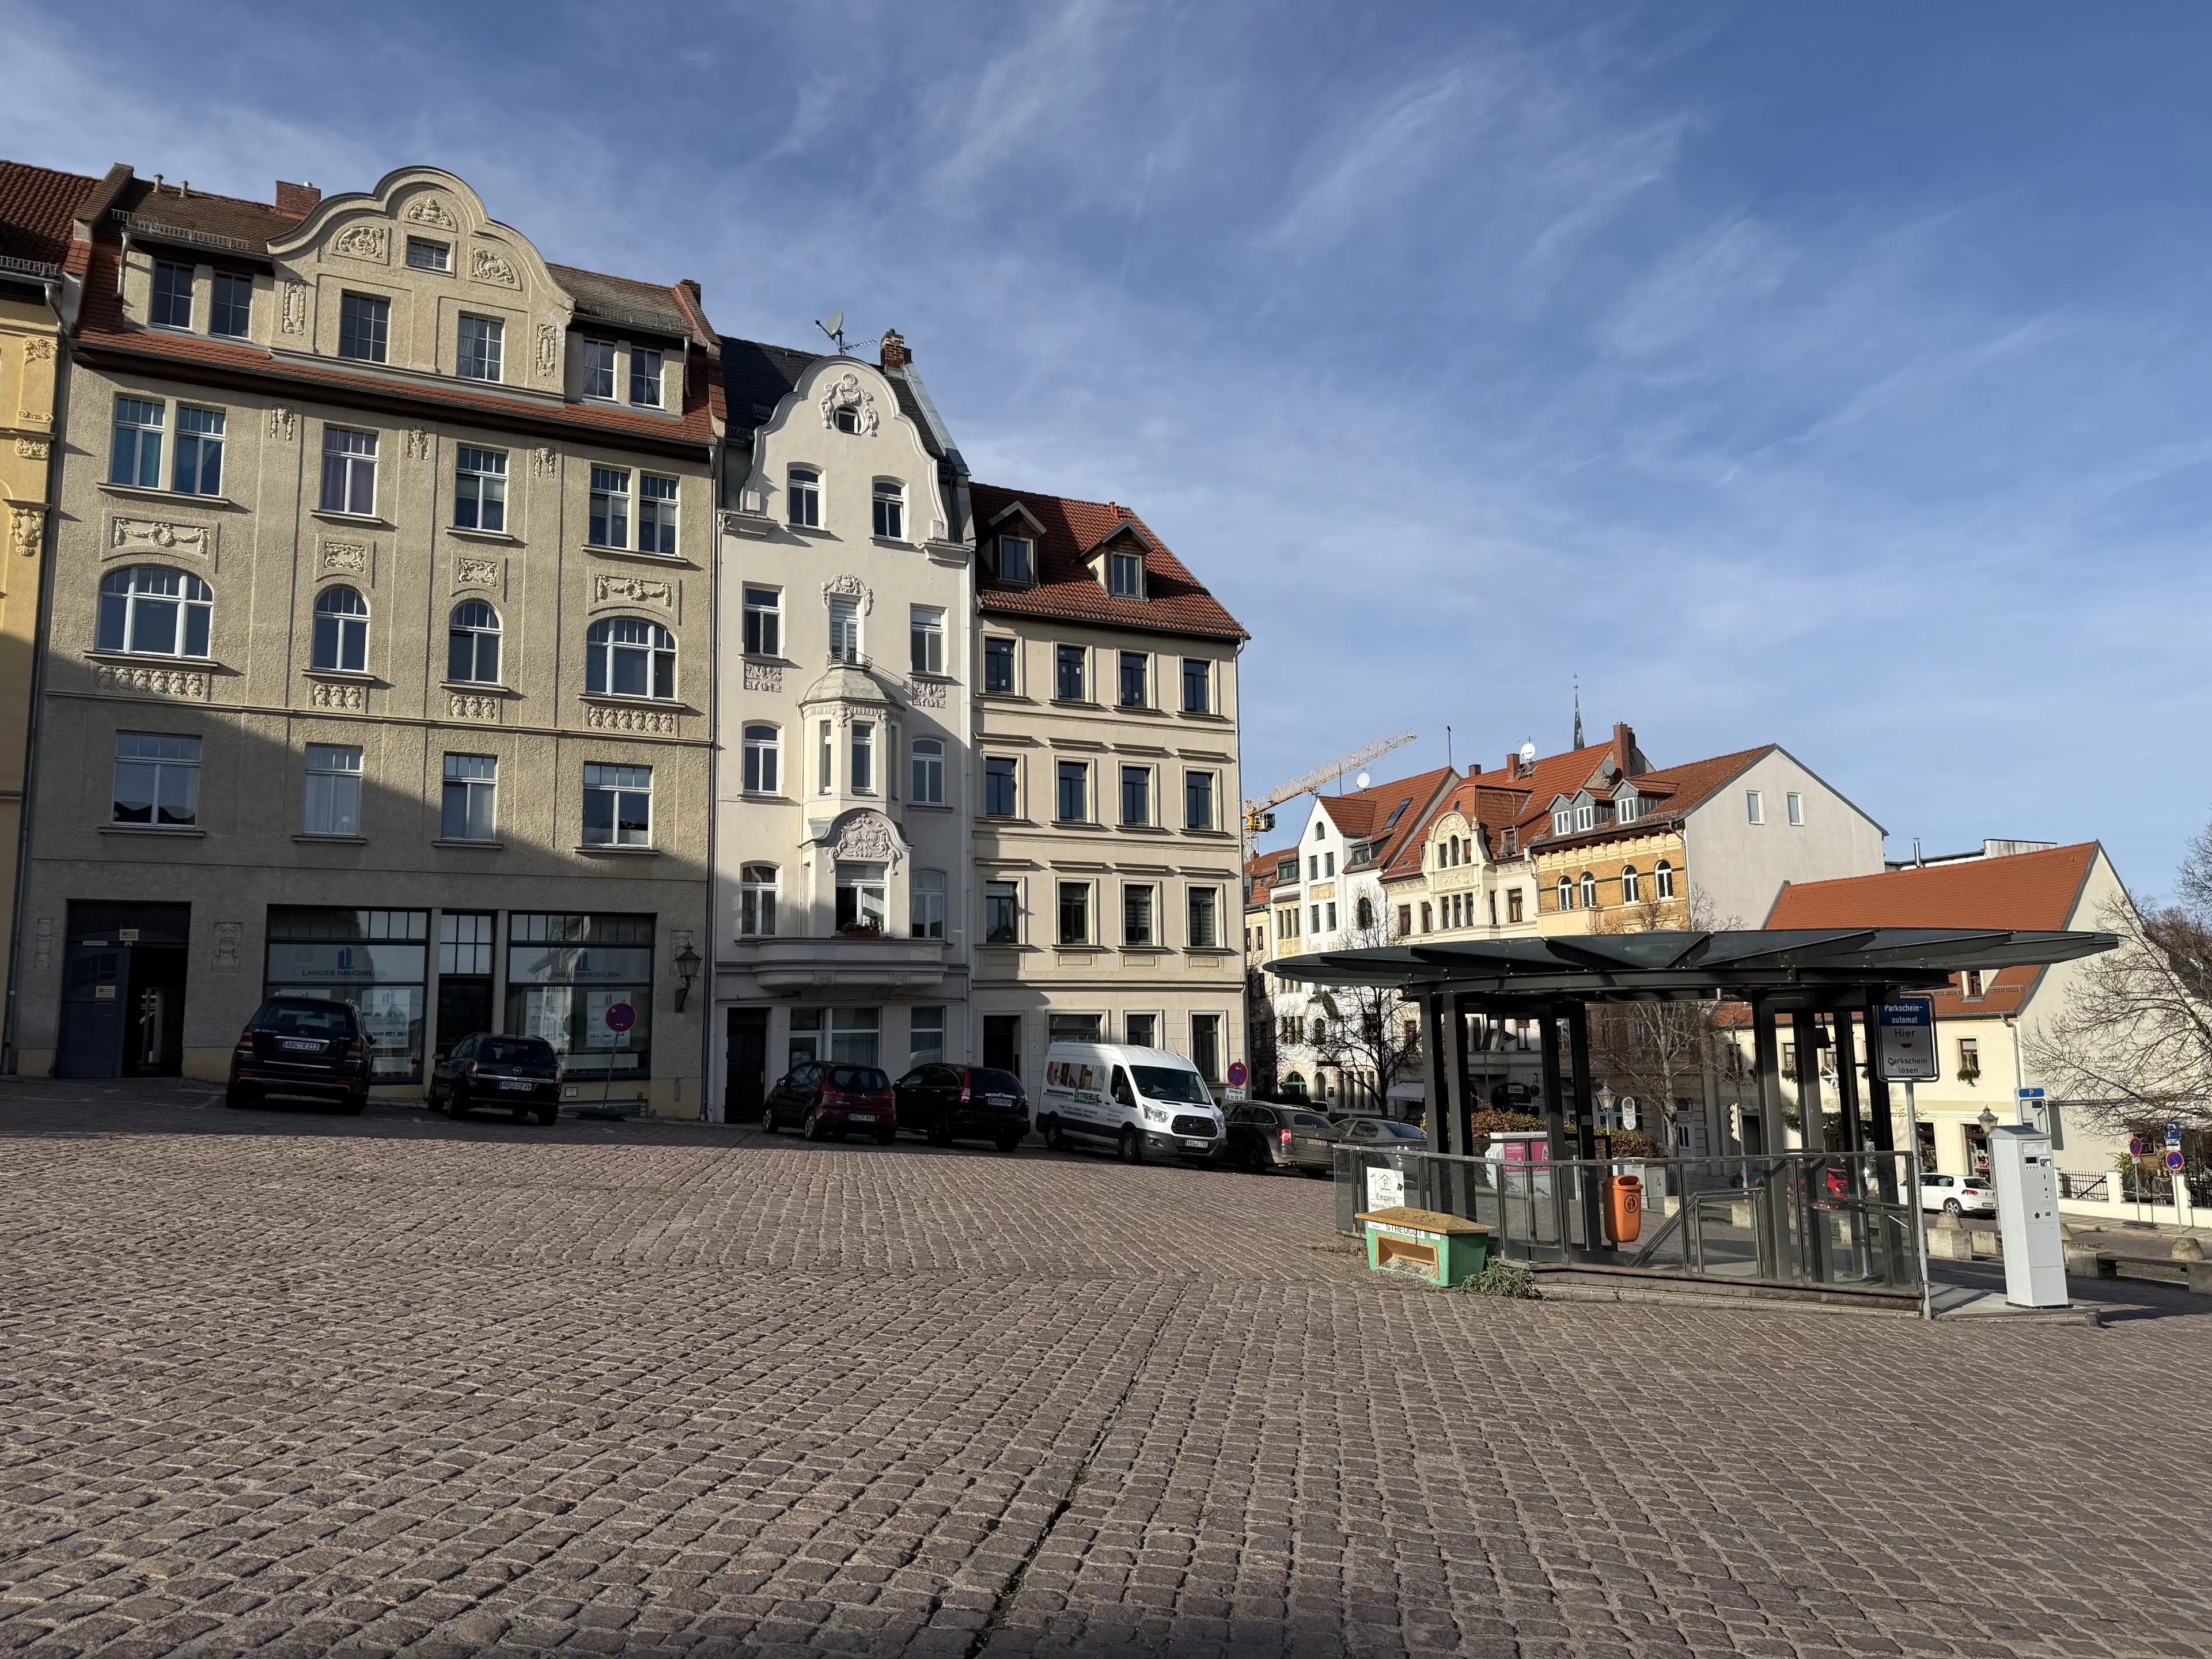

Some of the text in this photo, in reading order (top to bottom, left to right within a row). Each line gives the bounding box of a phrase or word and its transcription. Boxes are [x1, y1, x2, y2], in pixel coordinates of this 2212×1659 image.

[1895, 1028, 1916, 1037] Hier
[1080, 1092, 1100, 1101] TREBUS
[1376, 1193, 1396, 1203] Eingang
[1386, 1224, 1422, 1237] STREUGUT
